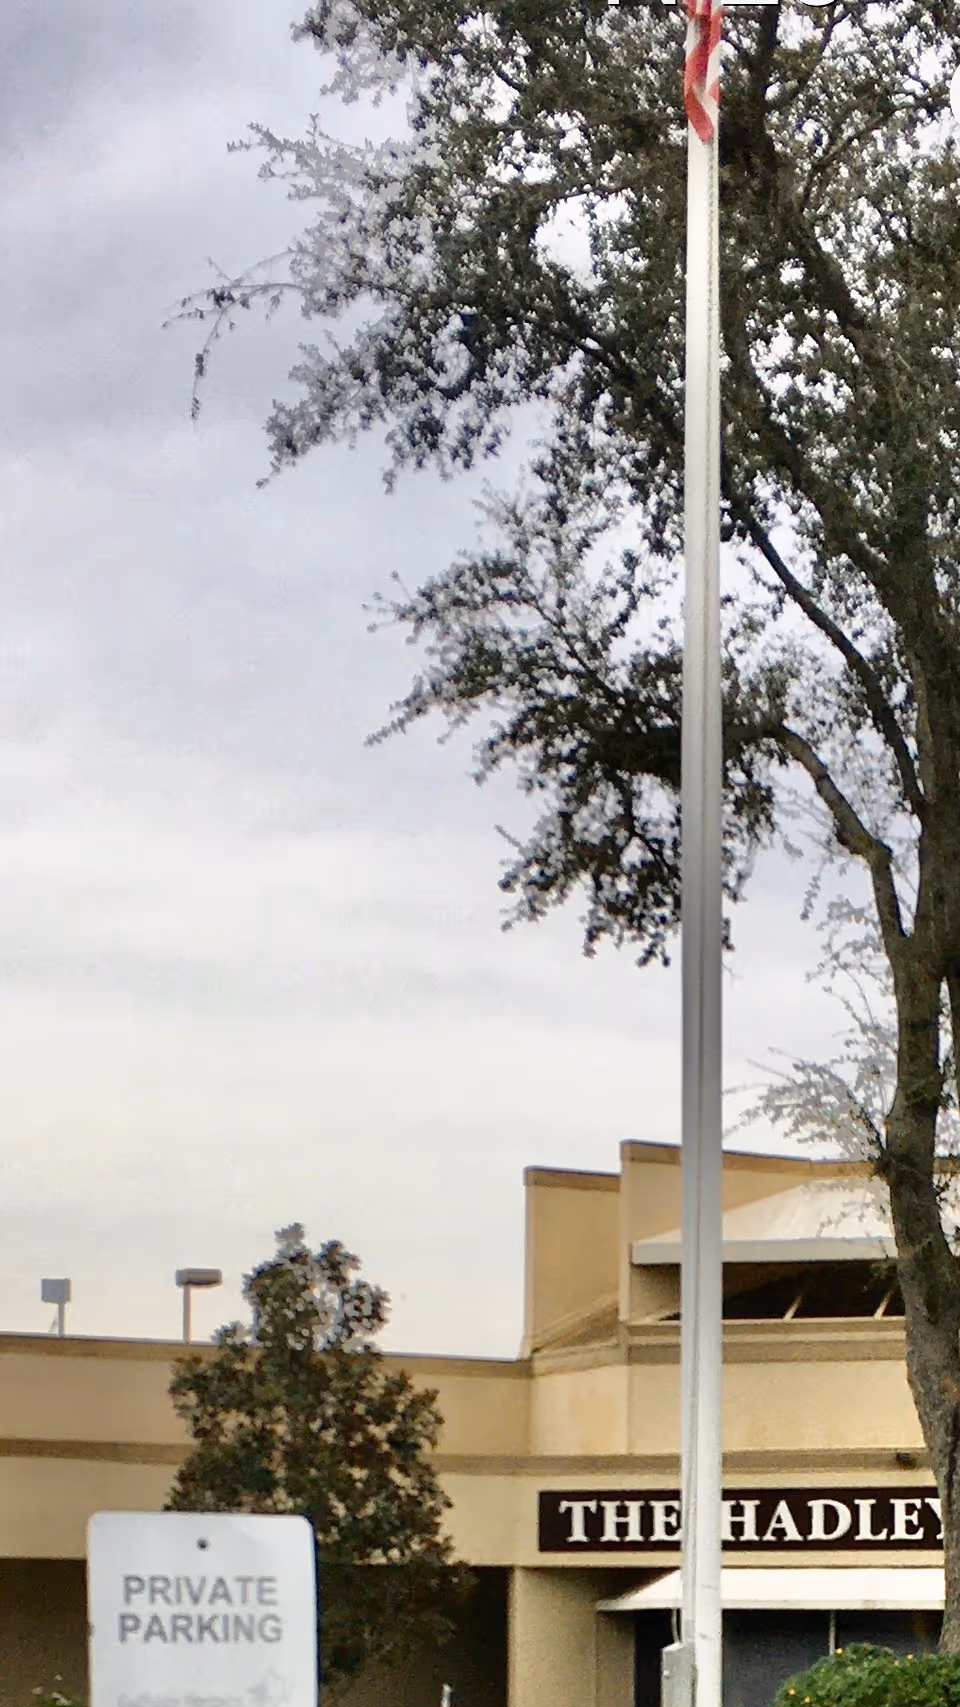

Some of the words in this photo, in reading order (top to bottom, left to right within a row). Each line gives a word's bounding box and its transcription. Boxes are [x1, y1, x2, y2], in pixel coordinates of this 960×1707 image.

[559, 1499, 681, 1543] THE
[123, 1575, 279, 1606] PRIVATE
[118, 1614, 283, 1644] PARKING
